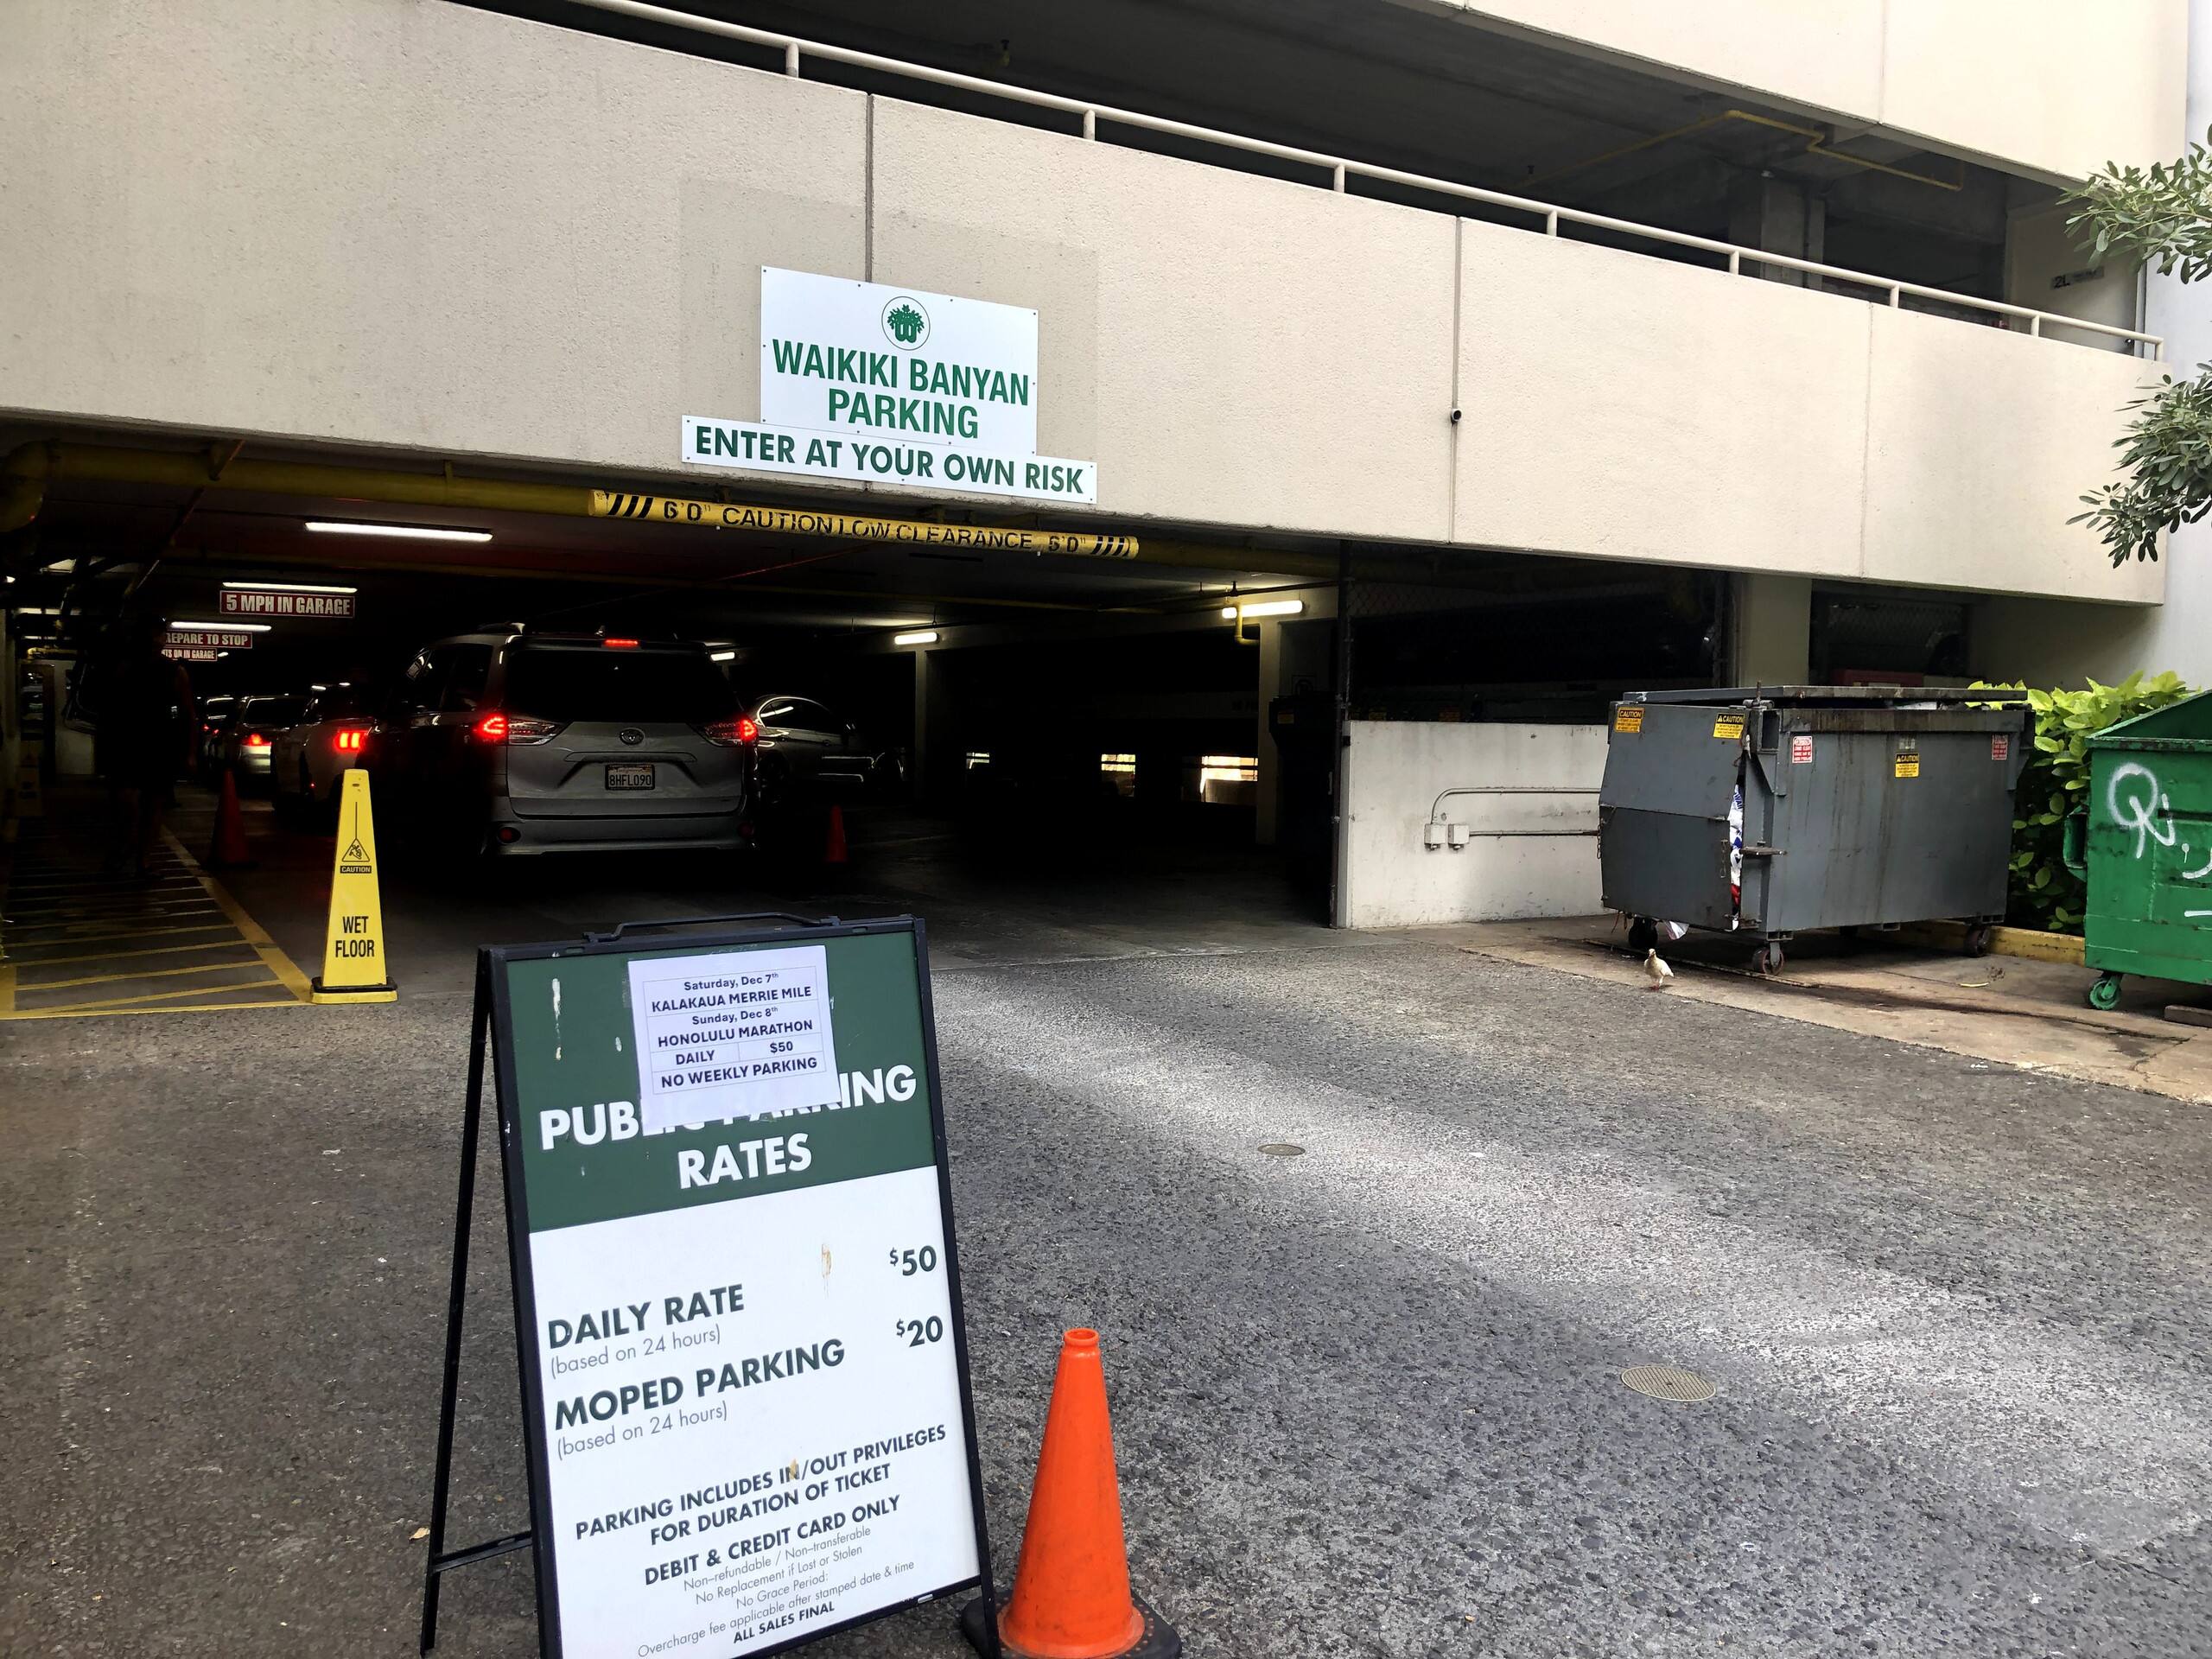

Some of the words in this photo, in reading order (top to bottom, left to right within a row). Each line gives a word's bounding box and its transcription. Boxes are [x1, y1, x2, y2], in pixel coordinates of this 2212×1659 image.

[772, 339, 898, 388] WAIKIKI
[910, 359, 1028, 406] BANYAN
[829, 389, 978, 438] PARKING
[696, 426, 795, 462] ENTER
[805, 439, 842, 468] AT
[851, 444, 933, 478] YOUR
[944, 455, 1014, 486] OWN
[1026, 465, 1084, 493] RISK
[722, 507, 832, 534] CAUTION
[838, 518, 891, 538] LOW
[896, 524, 1033, 550] CLEARANCE
[226, 594, 237, 611] 5
[240, 595, 272, 613] MPH
[277, 596, 293, 613] IN
[296, 597, 351, 615] GARAGE
[166, 632, 203, 645] REPARE
[206, 633, 219, 645] TO
[222, 635, 248, 645] STOP
[183, 650, 190, 658] IN
[192, 650, 215, 659] GARAGE
[1723, 715, 1744, 723] CAUTION
[609, 774, 652, 786] 8HFL090
[342, 916, 369, 933] WET
[335, 939, 375, 957] FLOOR
[651, 995, 727, 1013] KALAKAUA
[728, 988, 779, 1005] MERRIE
[781, 986, 812, 1000] MILE
[683, 978, 740, 993] Saturday,
[741, 974, 763, 987] Dec
[765, 972, 779, 984] 7th
[658, 1028, 735, 1048] HONOLULU
[737, 1019, 813, 1039] MARATHON
[691, 1011, 737, 1026] Sunday,
[740, 1007, 763, 1020] Dec
[765, 1006, 779, 1018] 8th
[675, 1050, 715, 1065] DAILY
[769, 1040, 794, 1055] $50
[660, 1073, 684, 1088] NO
[687, 1064, 750, 1084] WEEKLY
[753, 1056, 817, 1076] PARKING
[539, 1100, 705, 1151] PUB
[677, 1133, 812, 1190] RATES
[888, 1245, 937, 1277] $50
[548, 1301, 652, 1350] DAILY
[664, 1283, 745, 1325] RATE
[896, 1315, 944, 1347] $20
[550, 1345, 609, 1380] (based
[615, 1344, 637, 1363] on
[643, 1335, 666, 1357] 24
[671, 1324, 721, 1350] hours)
[554, 1375, 684, 1431] MOPED
[696, 1338, 845, 1398] PARKING
[557, 1427, 616, 1460] (based
[622, 1424, 644, 1442] on
[649, 1414, 674, 1436] 24
[678, 1400, 728, 1429] hours)
[575, 1498, 674, 1540] PARKING
[680, 1471, 773, 1512] INCLUDES
[779, 1450, 848, 1485] IN/OUT
[854, 1424, 947, 1465] PRIVILEGES
[650, 1518, 691, 1546] FOR
[697, 1487, 799, 1534] DURATION
[804, 1478, 829, 1502] OF
[834, 1462, 892, 1493] TICKET
[645, 1554, 700, 1586] DEBIT
[706, 1548, 722, 1567] &
[728, 1527, 791, 1560] CREDIT
[797, 1511, 847, 1541] CARD
[851, 1494, 901, 1526] ONLY
[683, 1556, 772, 1592] Non-refundable
[785, 1525, 871, 1560] Non-transferable
[696, 1592, 714, 1605] No
[717, 1569, 785, 1599] Replacement
[788, 1565, 795, 1577] if
[798, 1560, 817, 1574] Lost
[819, 1557, 830, 1567] or
[833, 1546, 862, 1563] Stolen
[736, 1597, 754, 1610] No
[757, 1586, 790, 1603] Grace
[793, 1571, 829, 1592] Period:
[638, 1630, 706, 1658] Overcharge
[709, 1622, 727, 1636] fee
[729, 1600, 785, 1630] applicable
[788, 1595, 811, 1609] after
[815, 1580, 856, 1600] stamped
[860, 1570, 881, 1586] date
[884, 1566, 893, 1578] &
[894, 1560, 914, 1575] time
[734, 1630, 756, 1643] ALL
[759, 1613, 795, 1635] SALES
[798, 1601, 836, 1621] FINAL
